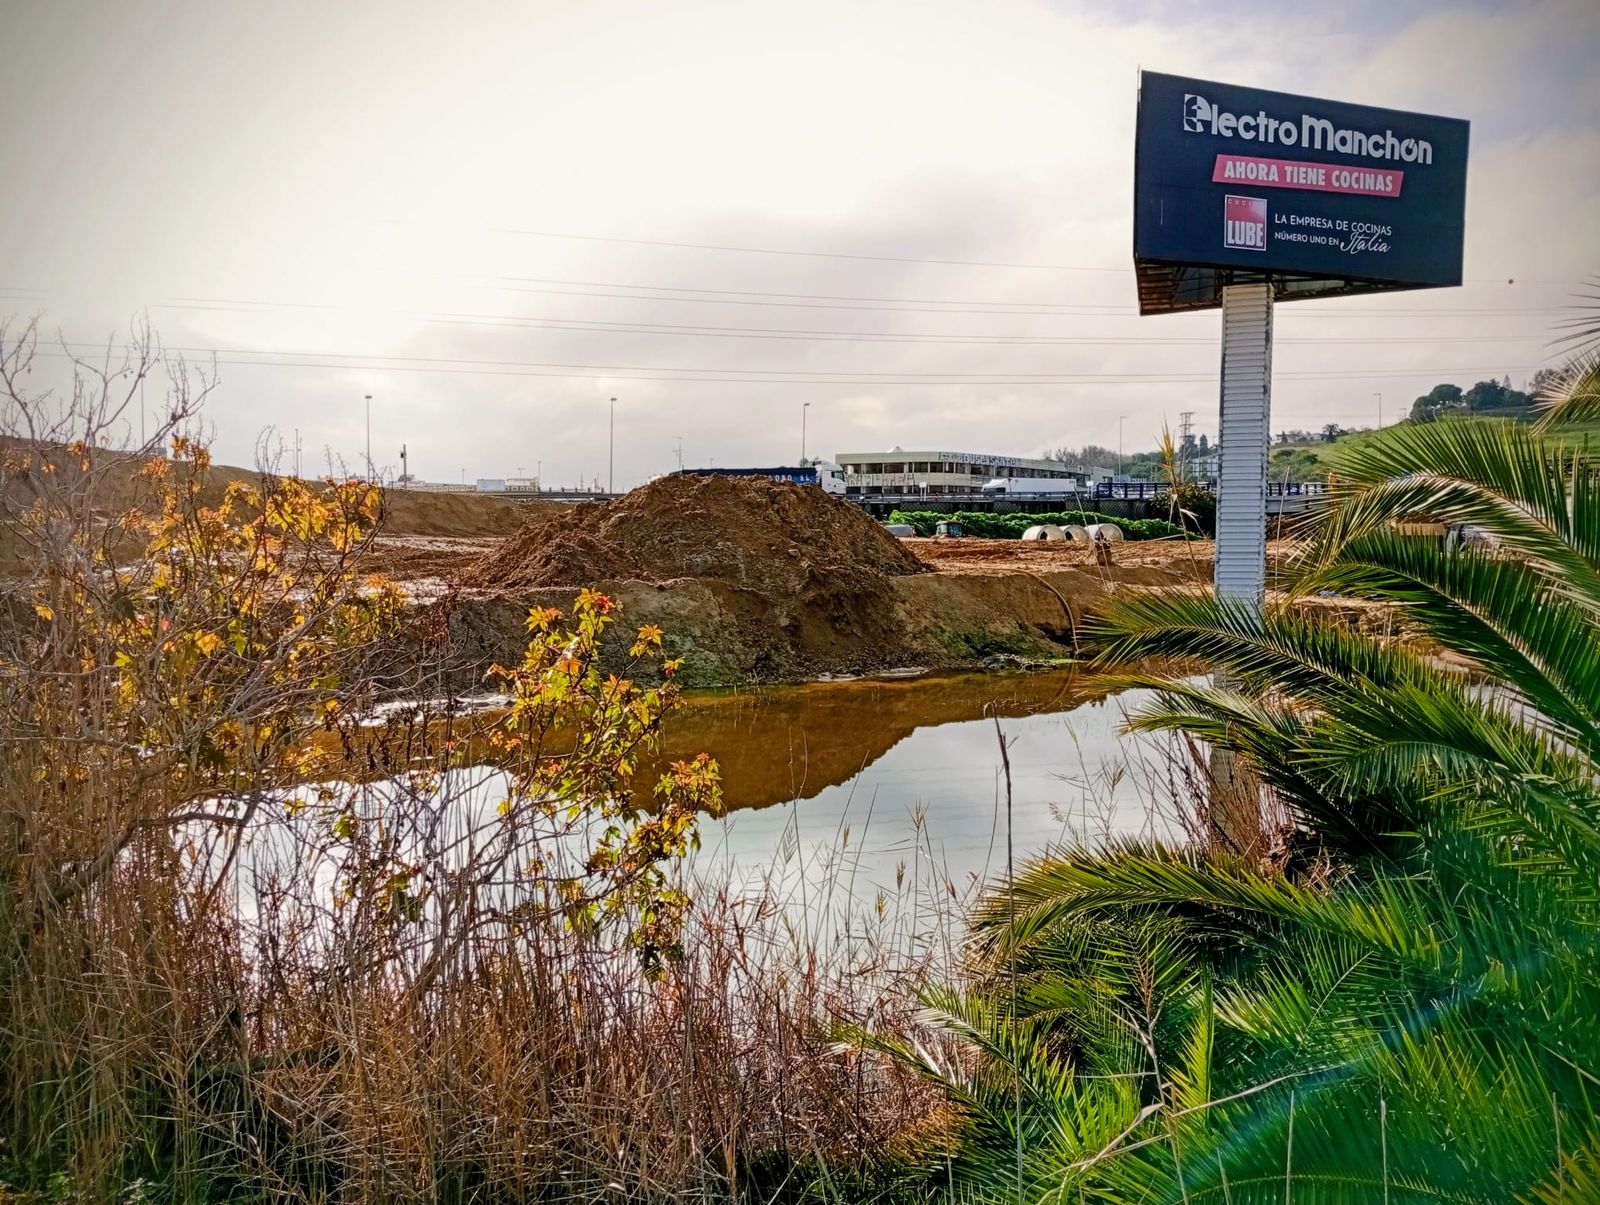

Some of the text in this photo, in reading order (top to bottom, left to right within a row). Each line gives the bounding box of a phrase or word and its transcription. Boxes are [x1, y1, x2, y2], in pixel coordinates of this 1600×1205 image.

[1184, 94, 1298, 146] Electro
[1224, 160, 1393, 192] AHORA TIENE COCINAS
[1227, 220, 1264, 247] LUBE
[1274, 213, 1392, 236] LA EMPRESA DE COCINAS
[1274, 227, 1391, 254] NÚMERO UNO EN Italia
